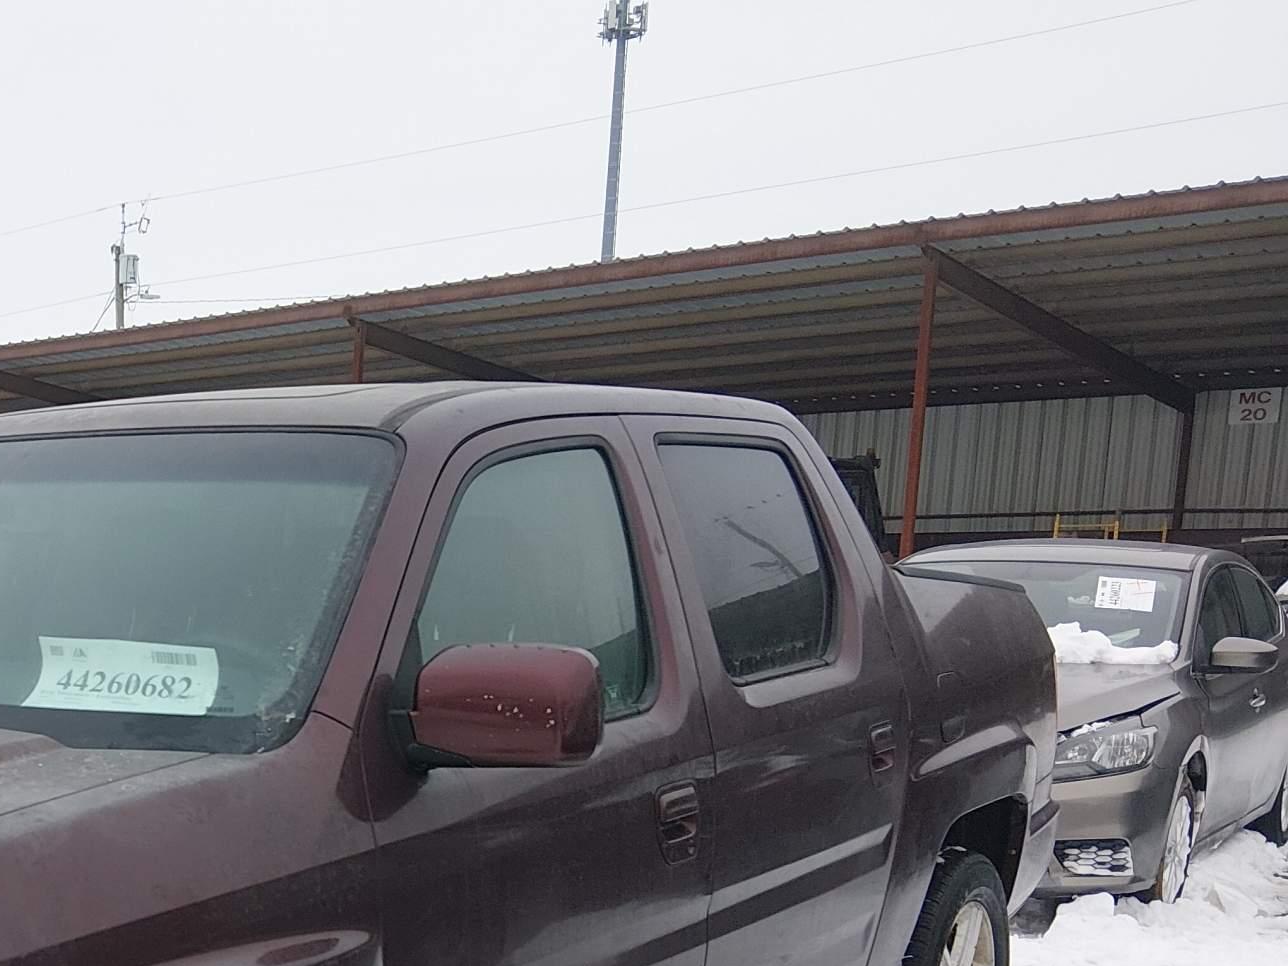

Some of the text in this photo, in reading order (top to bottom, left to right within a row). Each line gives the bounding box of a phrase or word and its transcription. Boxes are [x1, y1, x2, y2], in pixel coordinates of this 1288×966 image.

[1239, 391, 1272, 404] MC
[1240, 408, 1267, 421] 20
[56, 668, 195, 700] 44260682
